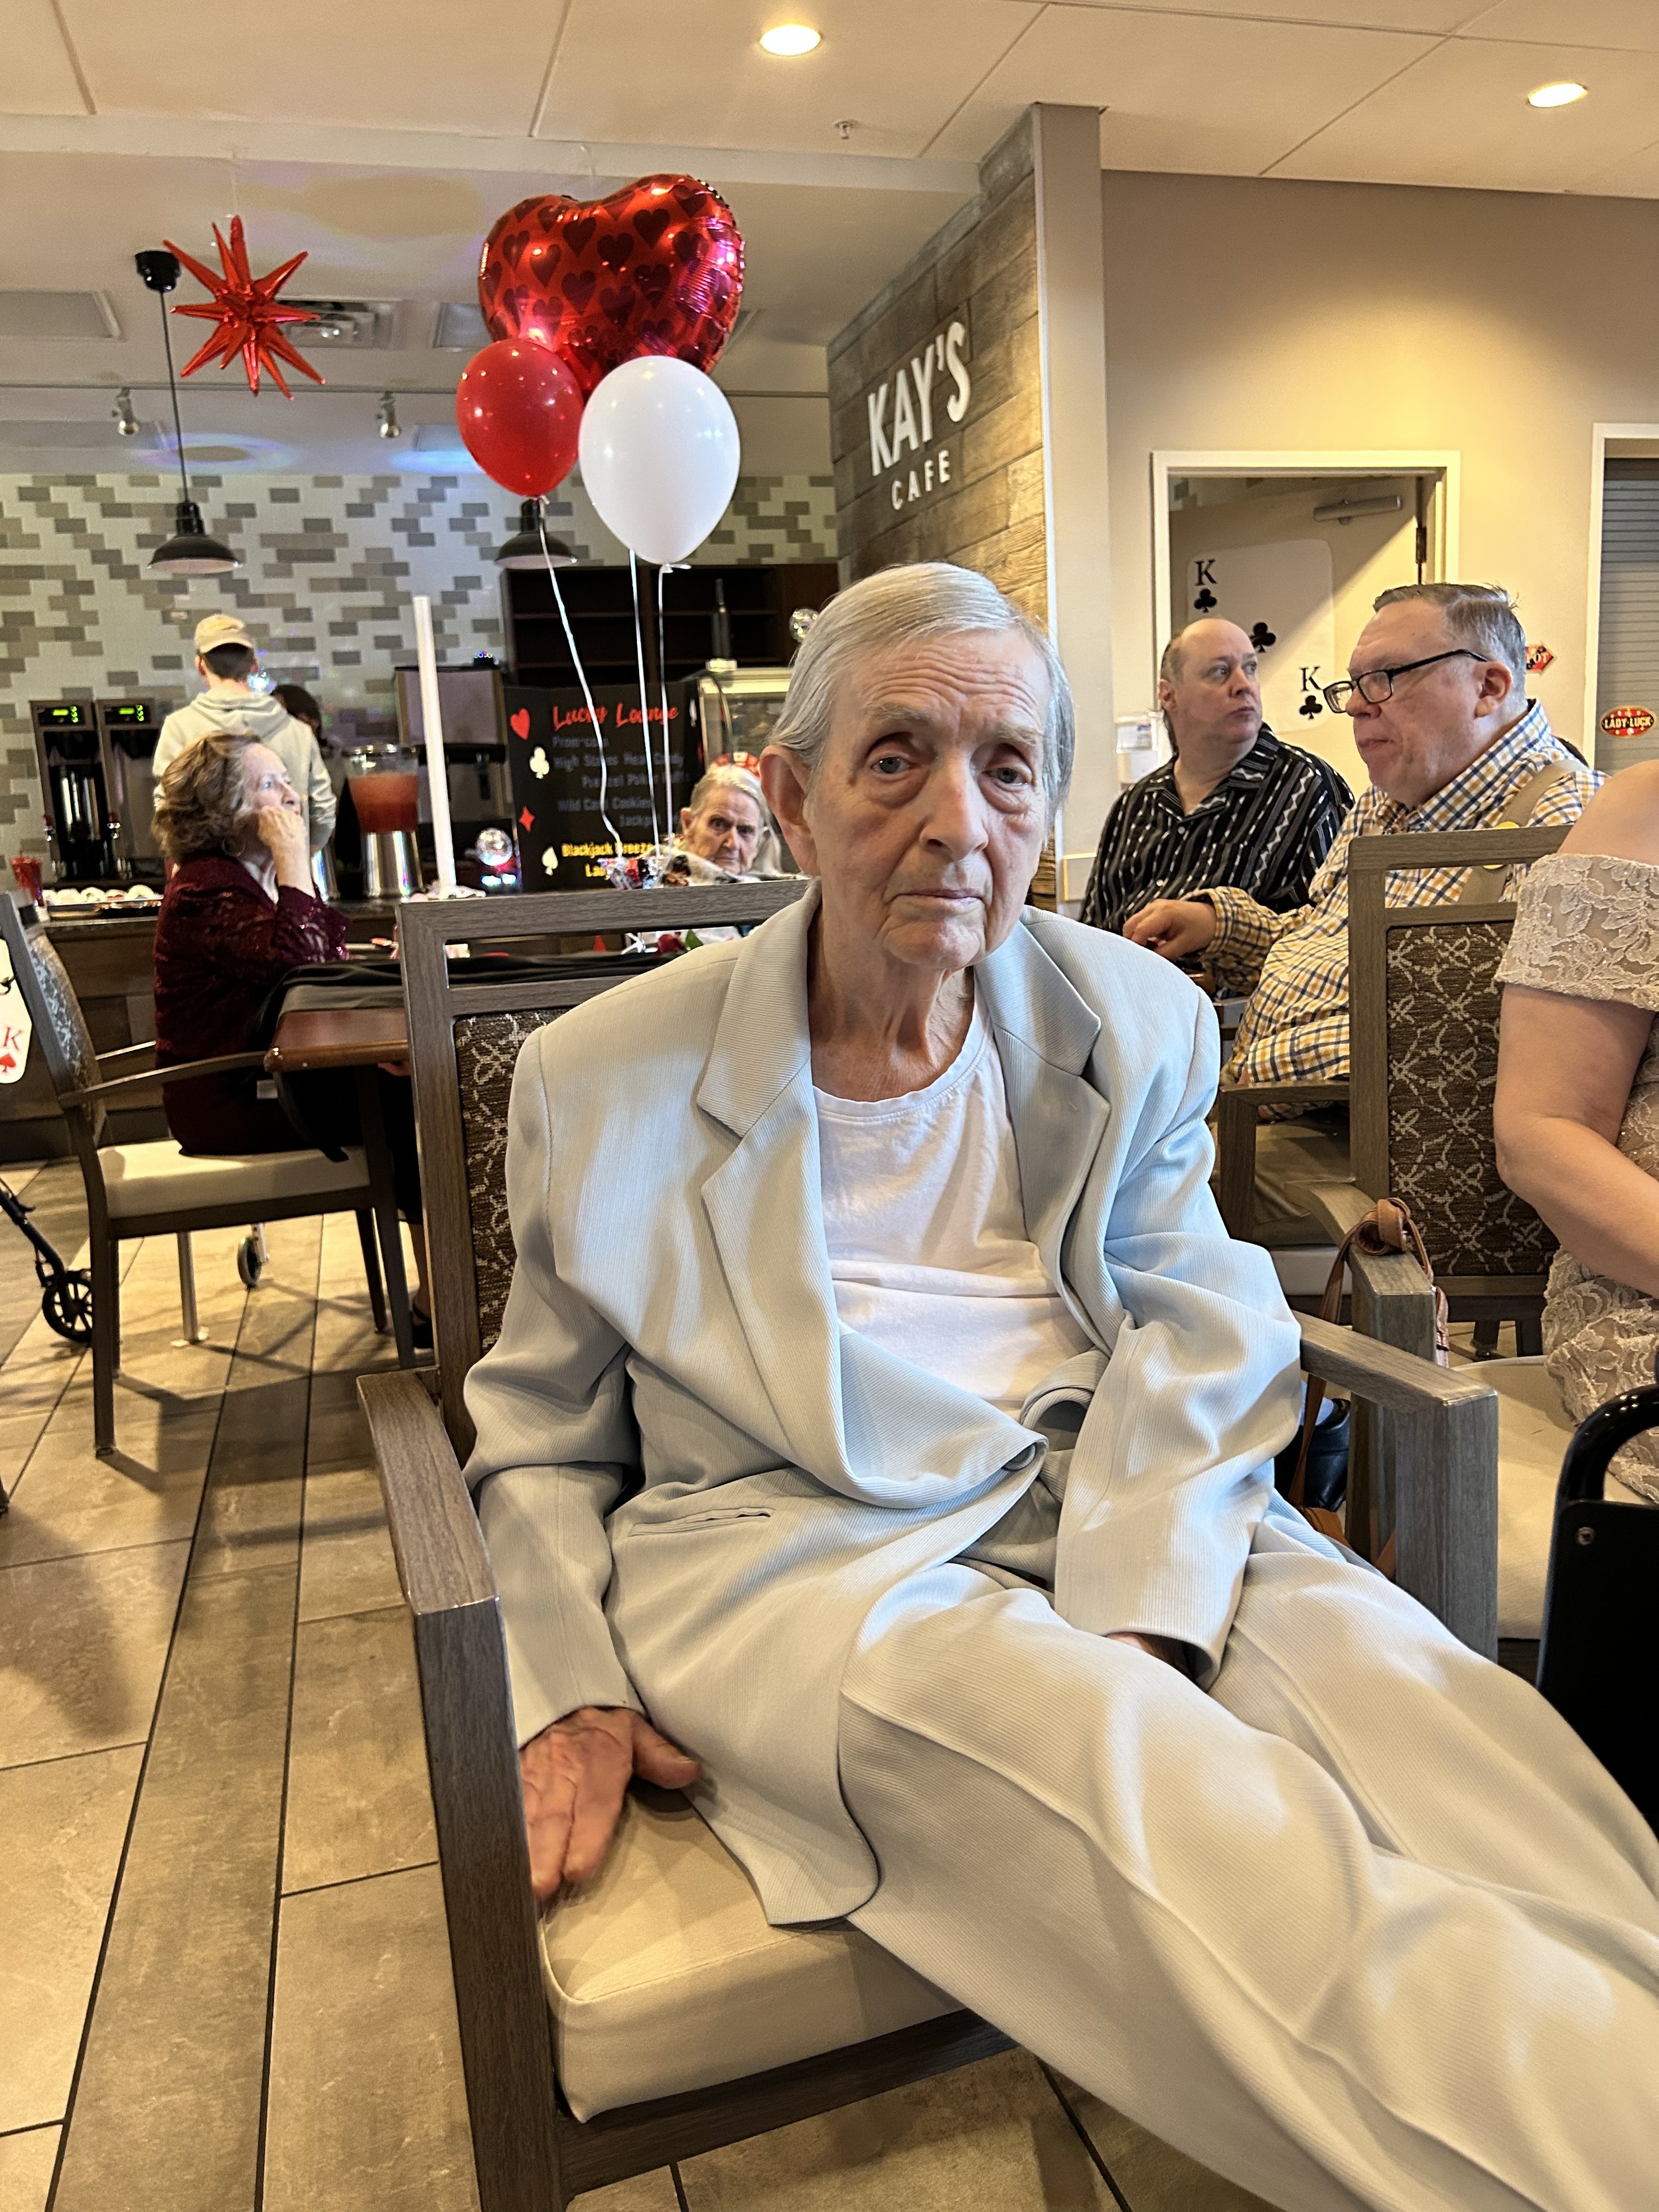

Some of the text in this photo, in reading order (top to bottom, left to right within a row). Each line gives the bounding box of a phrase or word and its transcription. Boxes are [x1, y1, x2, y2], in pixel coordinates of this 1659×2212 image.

[867, 321, 971, 477] KAY'S
[891, 450, 950, 510] CAFE
[1194, 559, 1217, 587] K
[1299, 666, 1323, 692] K
[1604, 716, 1651, 729] LADY LUCK
[561, 842, 613, 859] Blackjack
[3, 1027, 23, 1051] K
